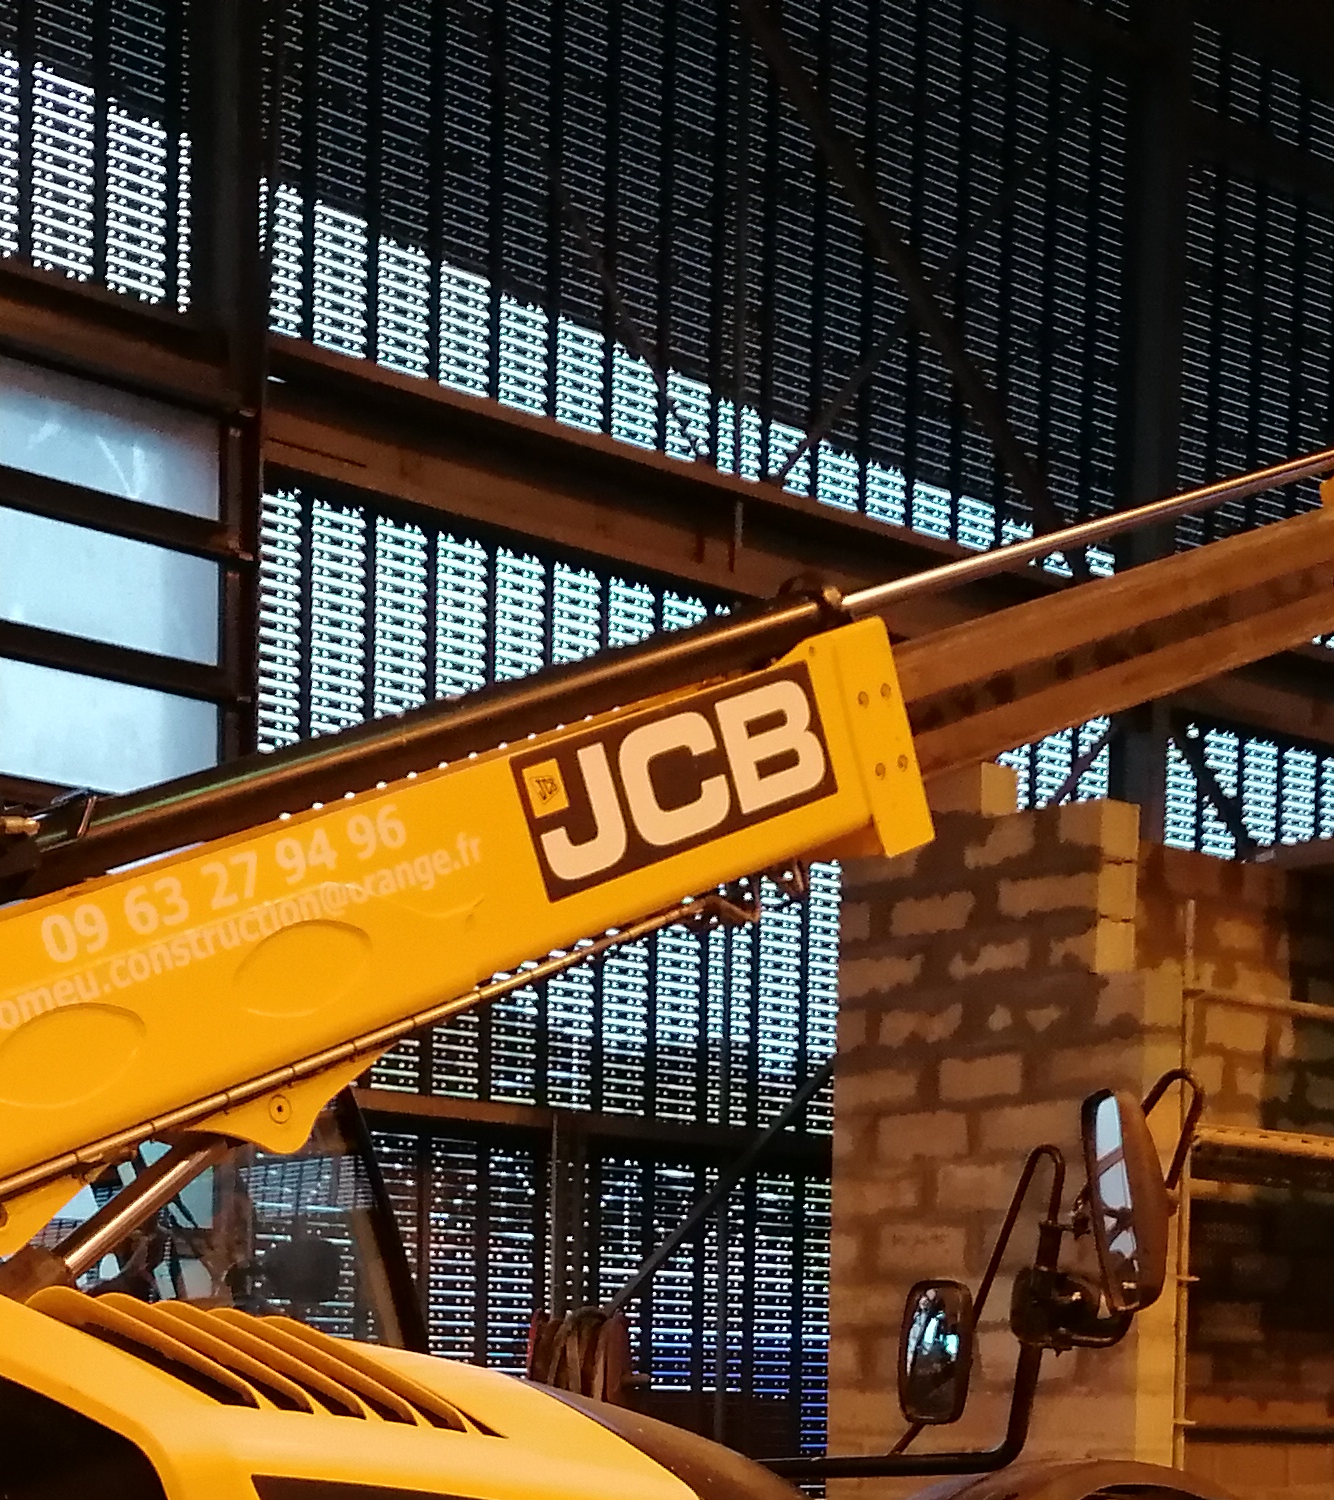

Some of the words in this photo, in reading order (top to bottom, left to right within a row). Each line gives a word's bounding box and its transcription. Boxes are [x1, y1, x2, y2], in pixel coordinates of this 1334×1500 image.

[540, 679, 827, 881] JCB
[40, 903, 109, 963] 09
[123, 876, 190, 935] 63
[200, 848, 258, 911] 27
[274, 826, 339, 885] 94
[346, 803, 408, 861] 96
